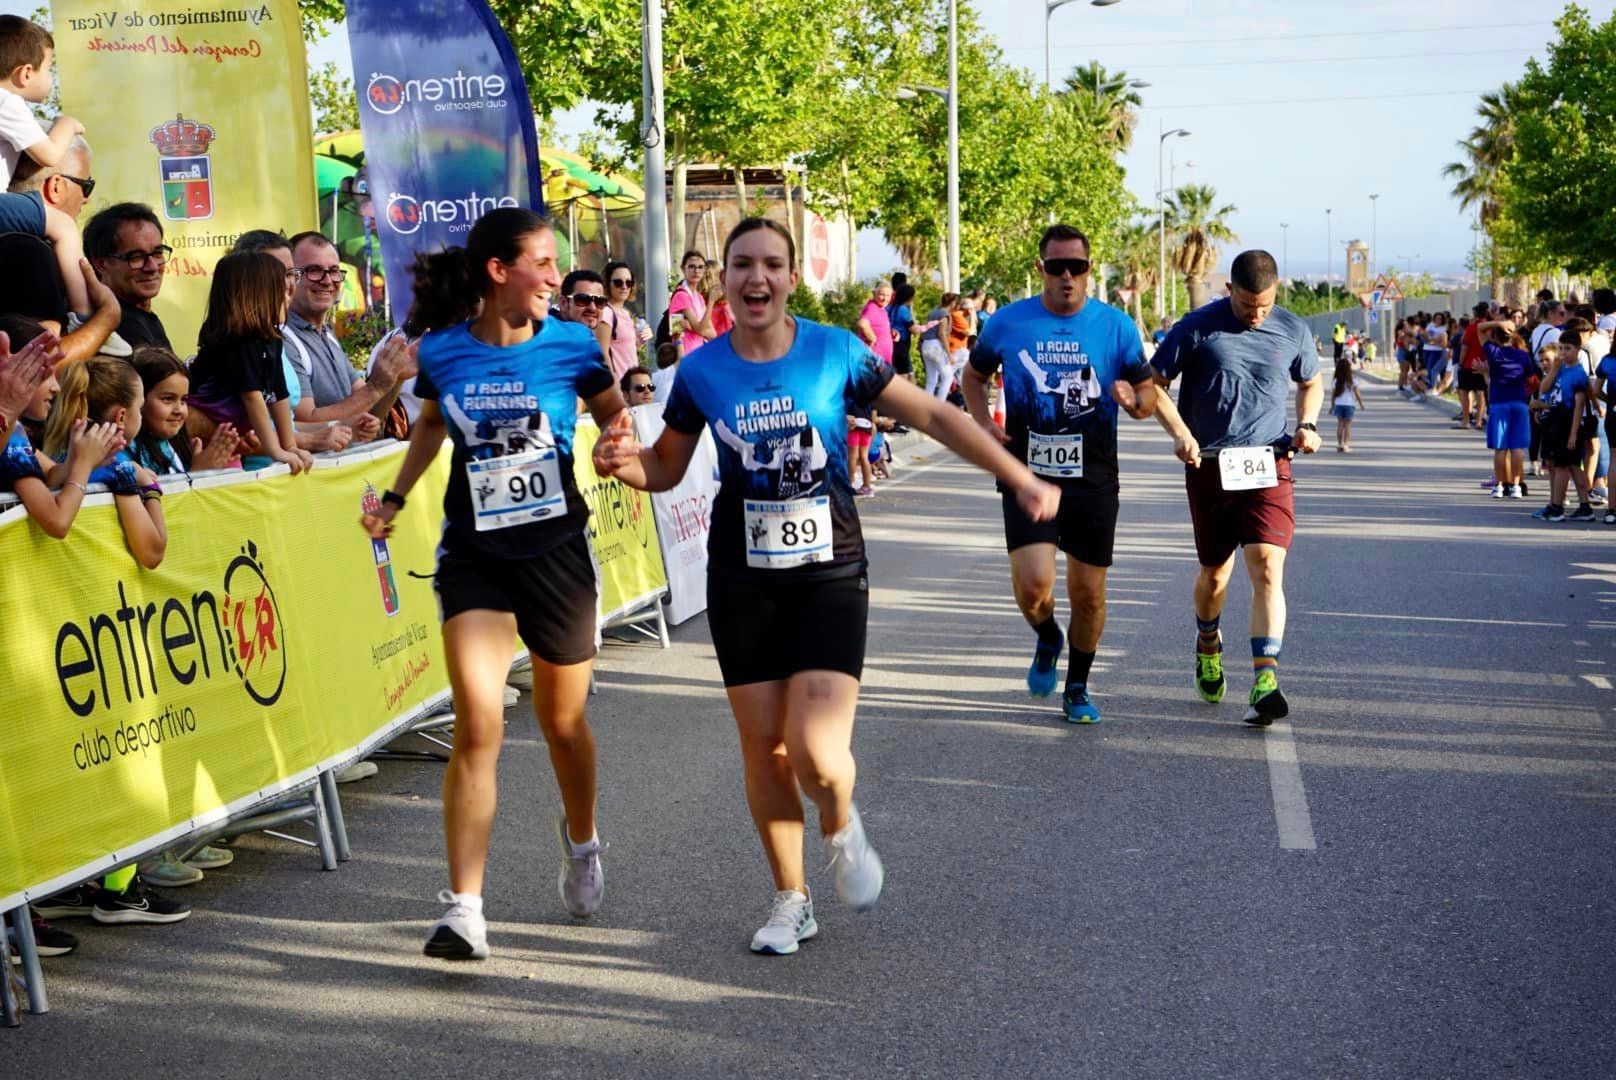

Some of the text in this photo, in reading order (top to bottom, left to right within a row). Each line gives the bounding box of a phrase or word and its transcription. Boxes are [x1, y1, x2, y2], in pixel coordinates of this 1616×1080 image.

[1047, 340, 1080, 352] ROAD
[1037, 352, 1089, 365] RUNNING
[479, 381, 525, 394] ROAD
[463, 395, 538, 411] RUNNING
[749, 395, 793, 417] ROAD
[736, 410, 809, 435] RUNNING
[1044, 446, 1081, 465] 104
[1243, 458, 1267, 476] 84
[508, 471, 547, 503] 90
[781, 518, 818, 546] 89
[73, 703, 197, 770] club deportivo
